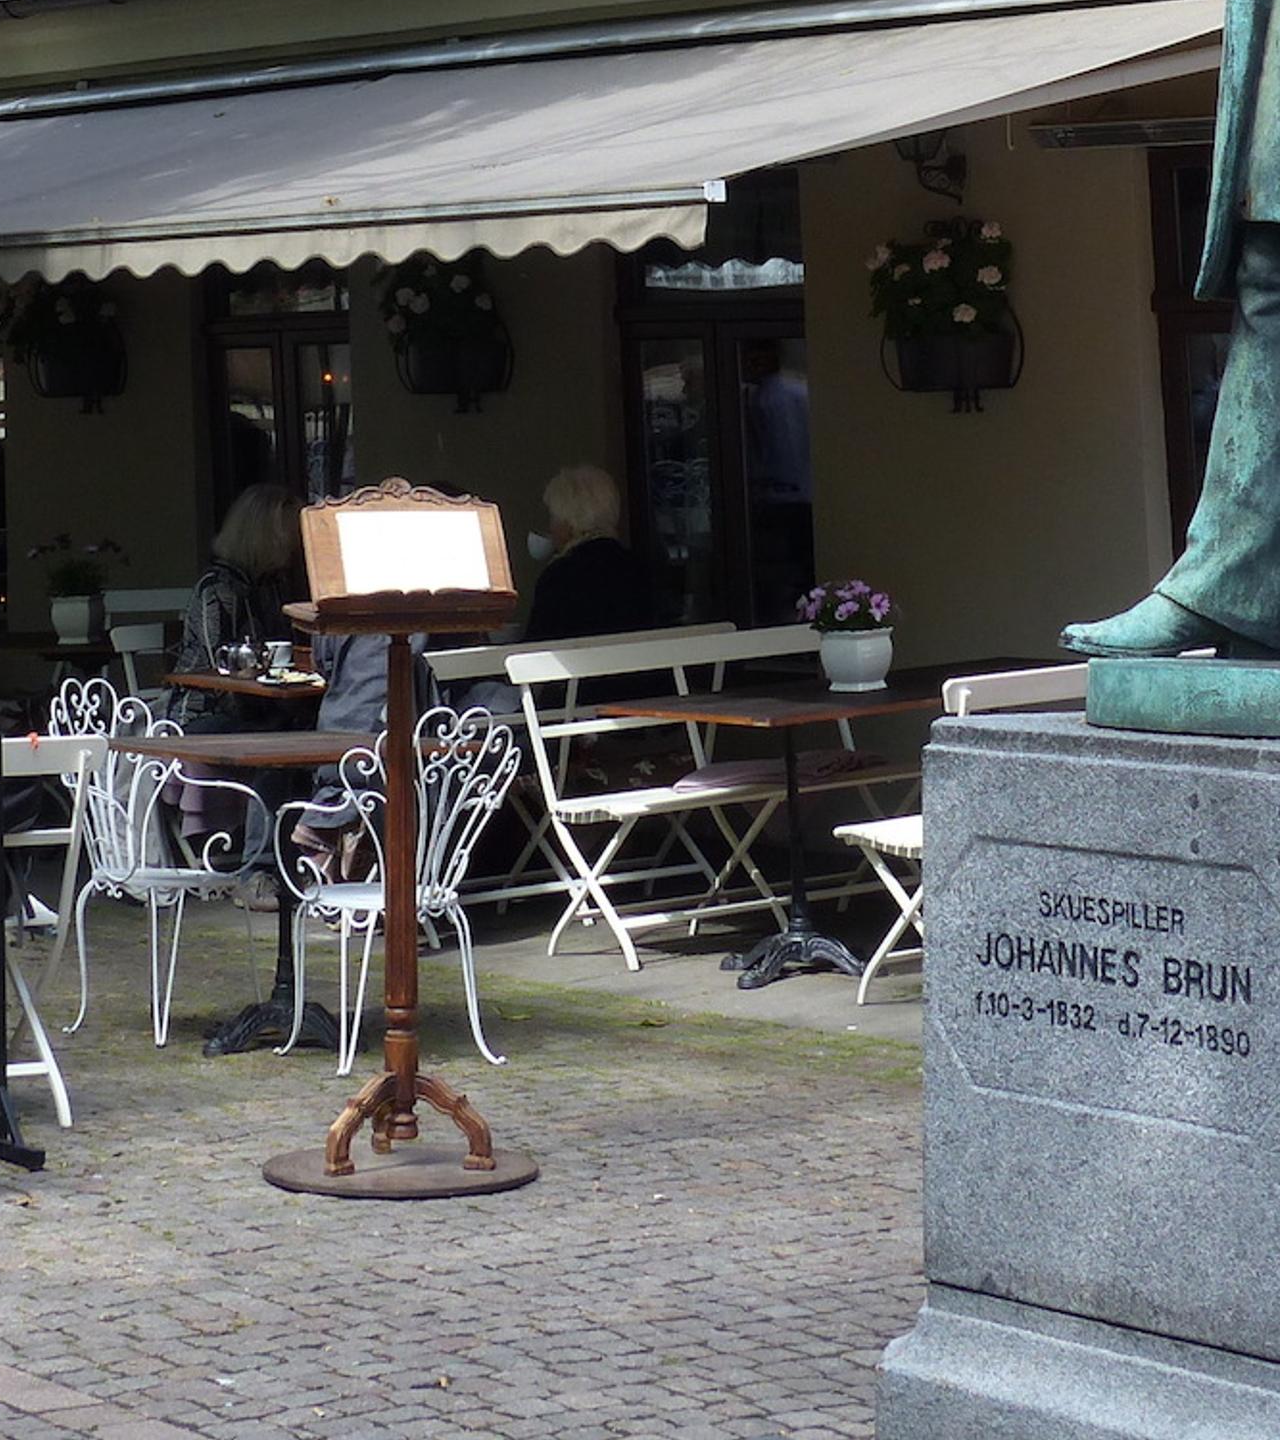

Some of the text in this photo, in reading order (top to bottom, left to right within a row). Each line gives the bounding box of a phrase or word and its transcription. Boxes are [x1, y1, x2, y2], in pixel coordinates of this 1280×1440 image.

[1038, 891, 1185, 935] SKUESPILLER
[976, 932, 1253, 1006] JOHANNES BRUN
